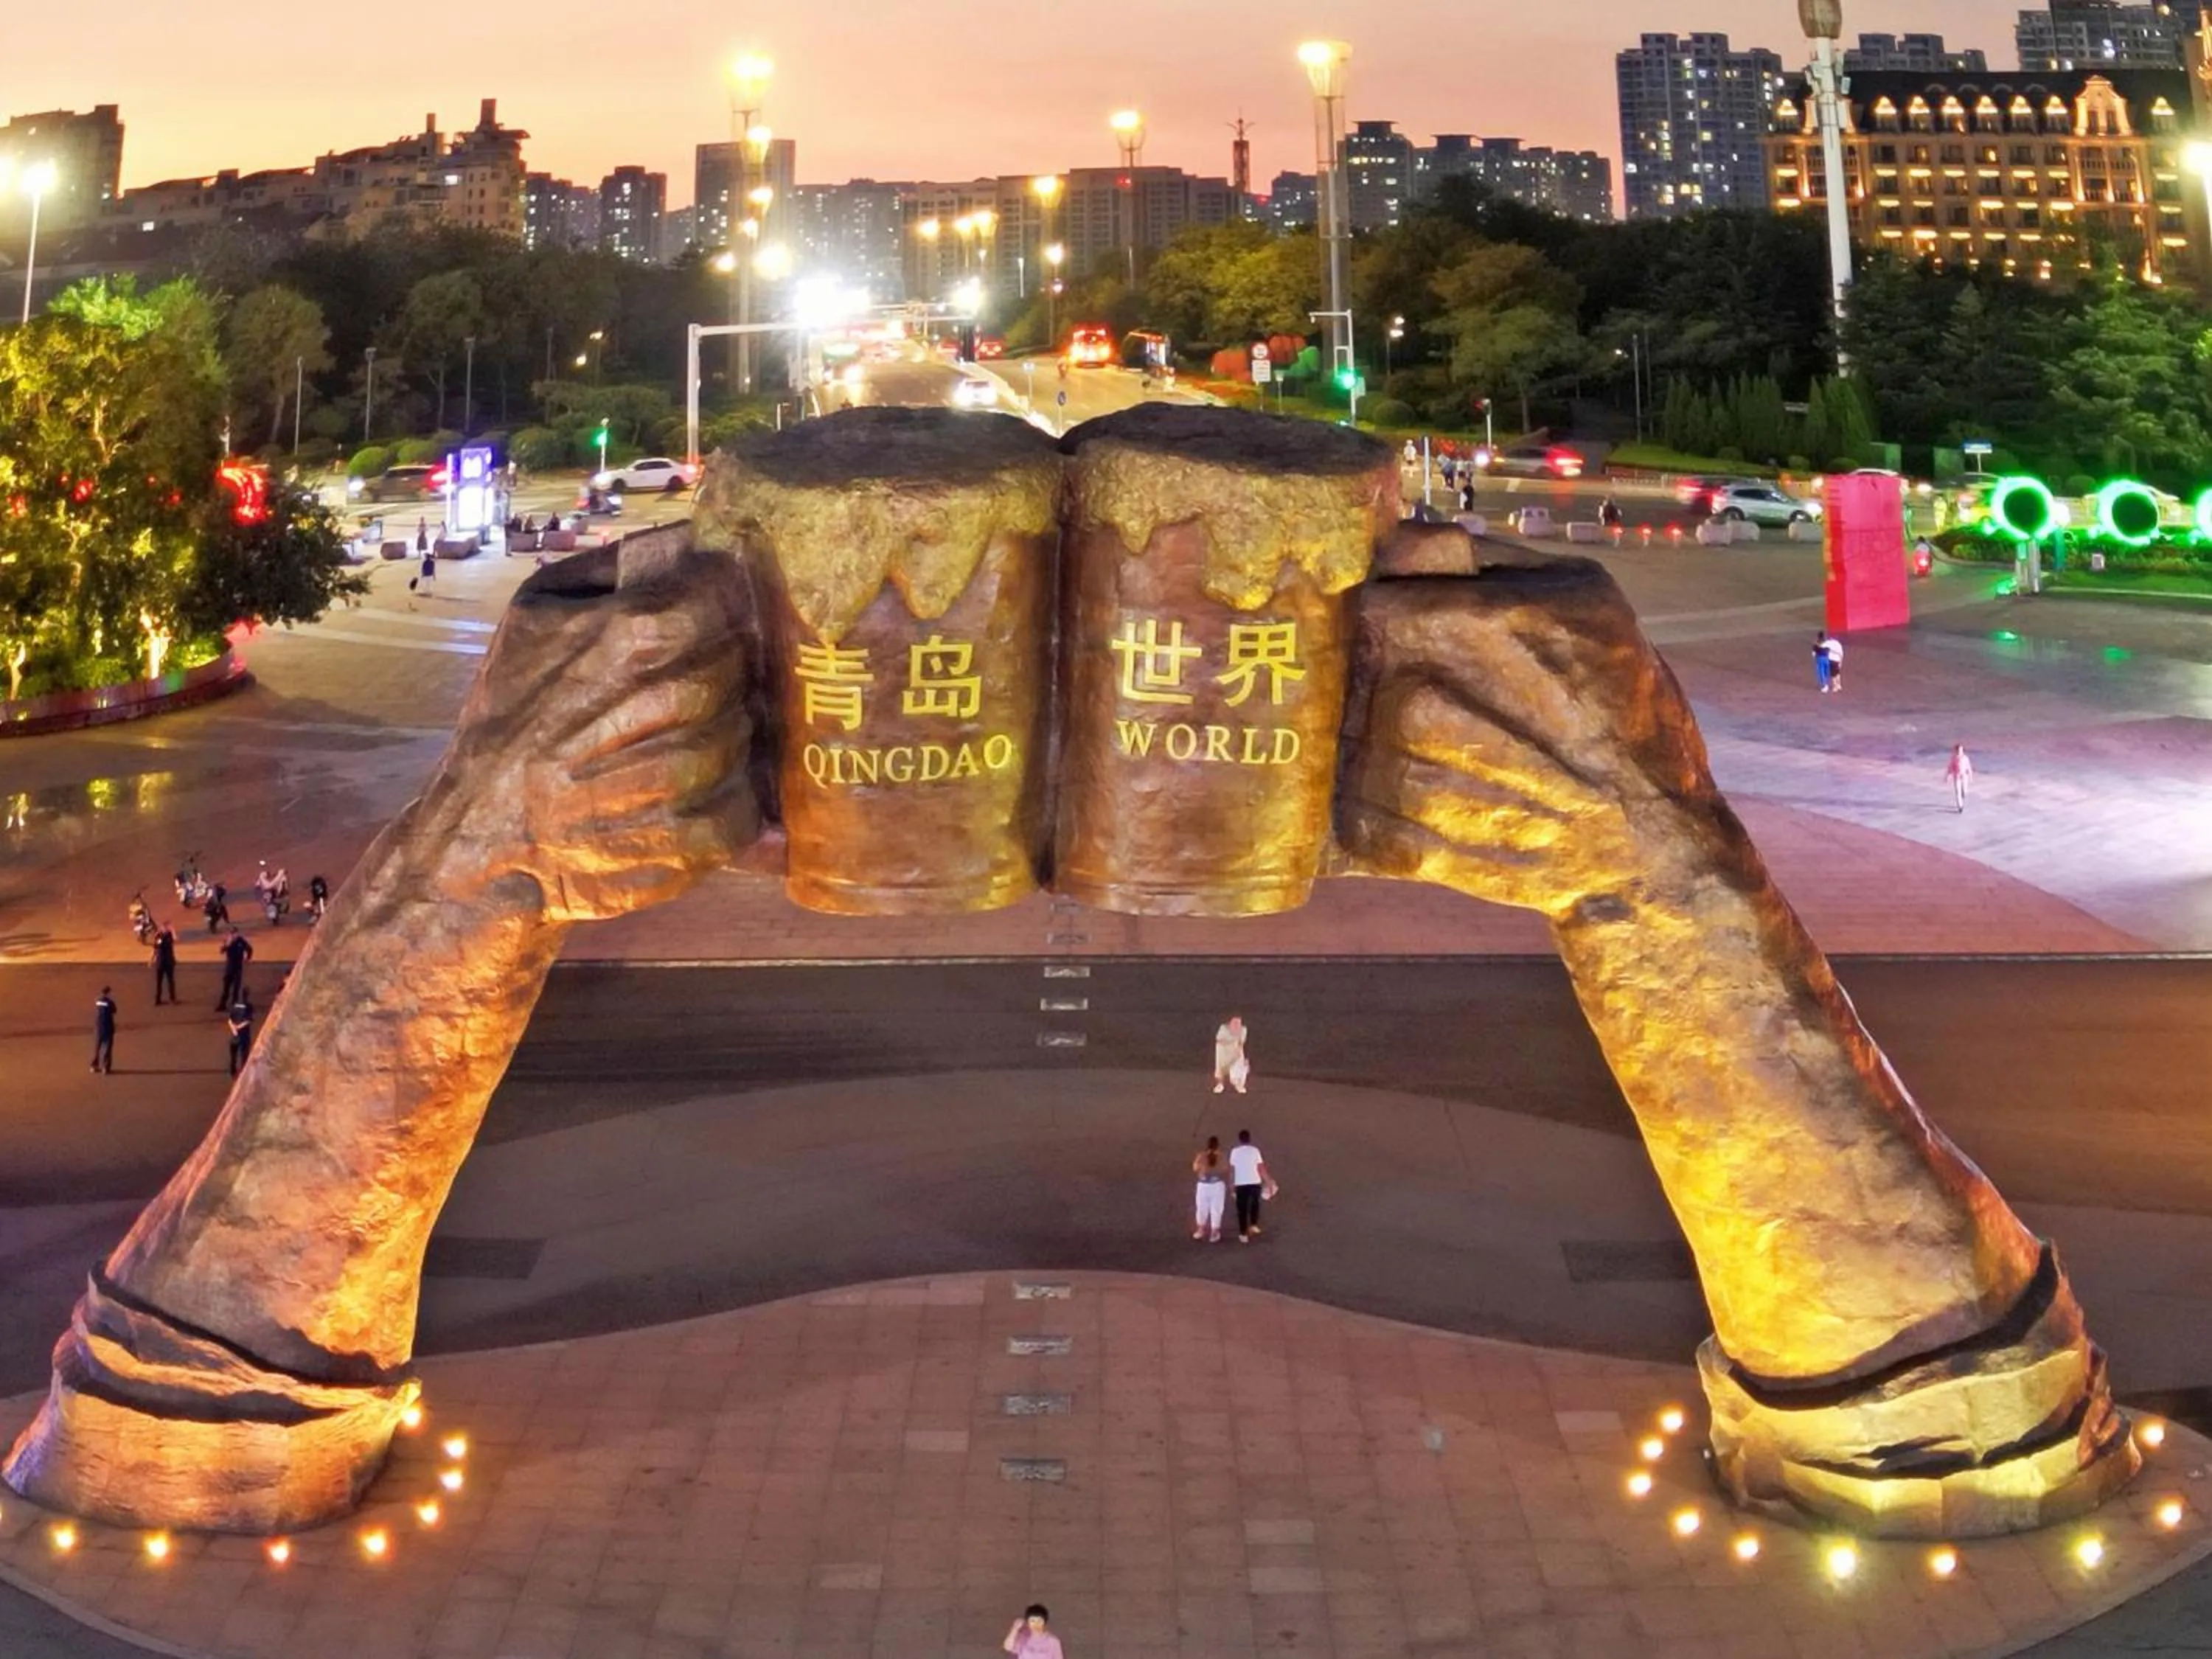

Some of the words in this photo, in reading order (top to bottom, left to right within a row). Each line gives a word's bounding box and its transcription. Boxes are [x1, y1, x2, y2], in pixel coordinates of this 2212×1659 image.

[794, 634, 982, 731] 青岛
[1110, 619, 1307, 707] 世界
[802, 734, 1013, 790] QINGDAO
[1115, 718, 1301, 765] WORLD
